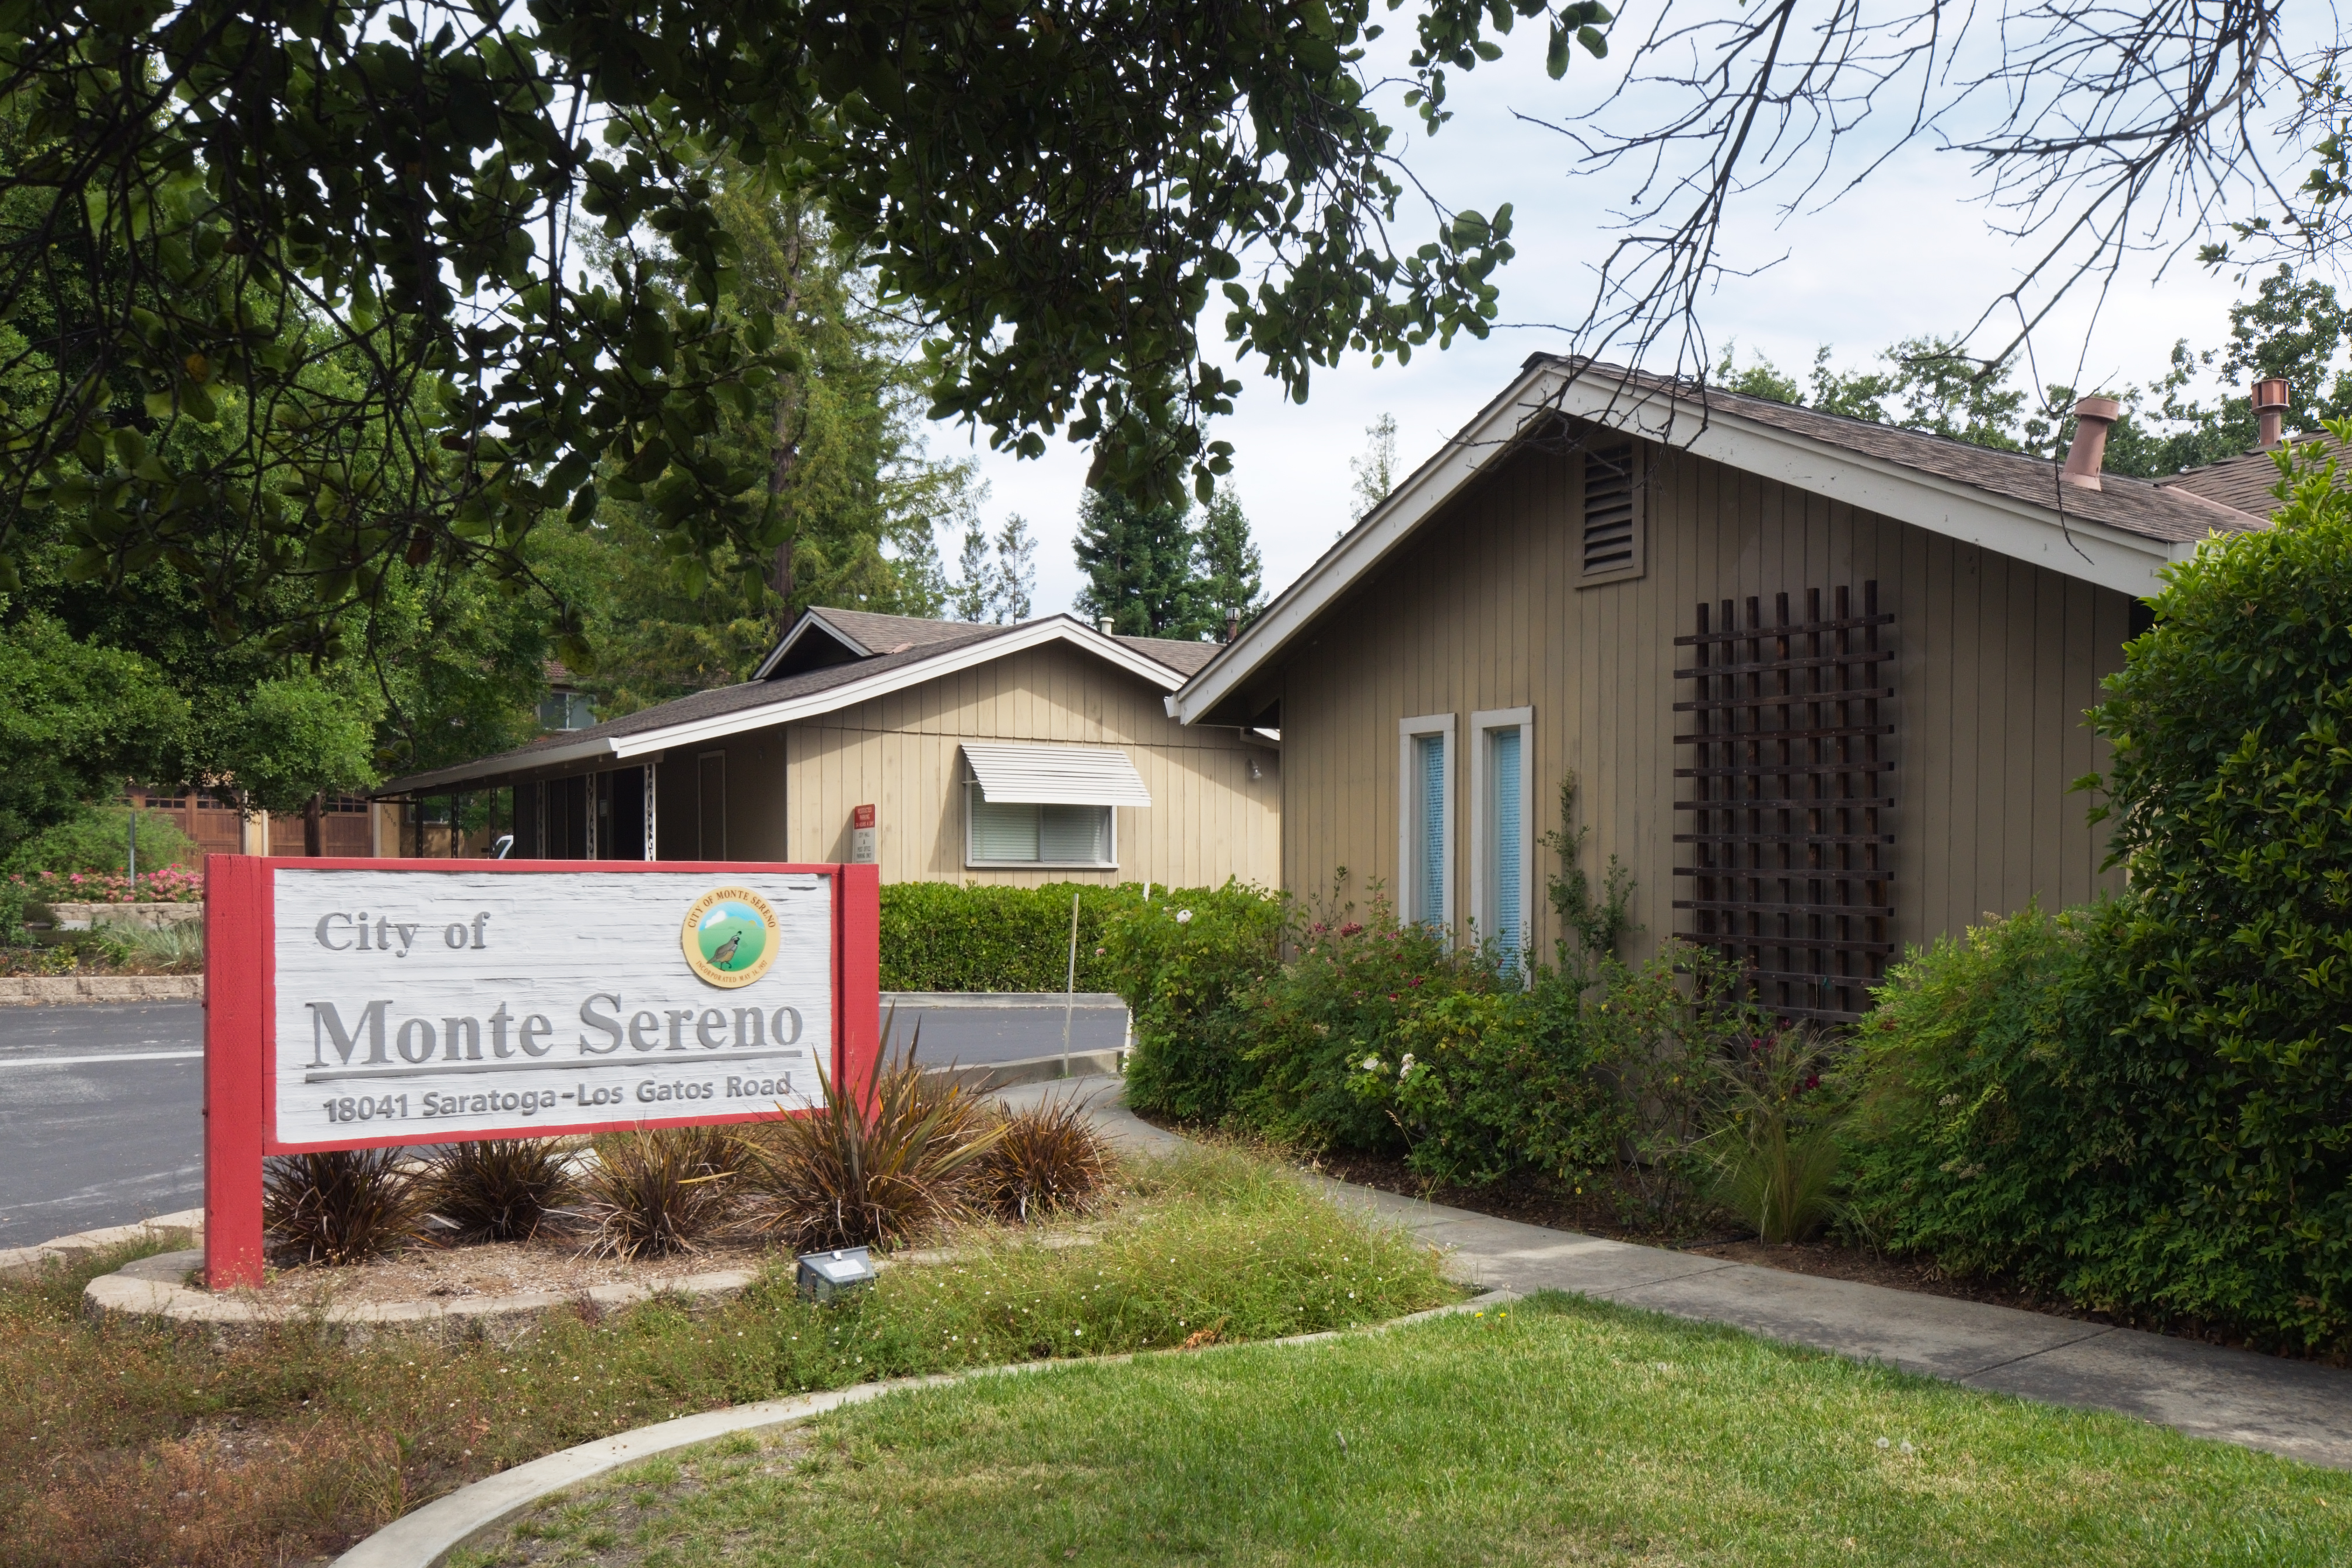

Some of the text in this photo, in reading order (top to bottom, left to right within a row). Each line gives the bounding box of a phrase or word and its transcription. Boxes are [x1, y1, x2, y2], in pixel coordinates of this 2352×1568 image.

[688, 890, 776, 928] CITY OF MONTE SERENO
[315, 911, 491, 957] City of
[696, 960, 737, 983] INCORPORATED
[758, 960, 767, 970] 1957
[305, 993, 803, 1069] Monte Sereno
[323, 1094, 408, 1122] 18041
[636, 1082, 713, 1102] Gatos
[726, 1072, 791, 1097] Road
